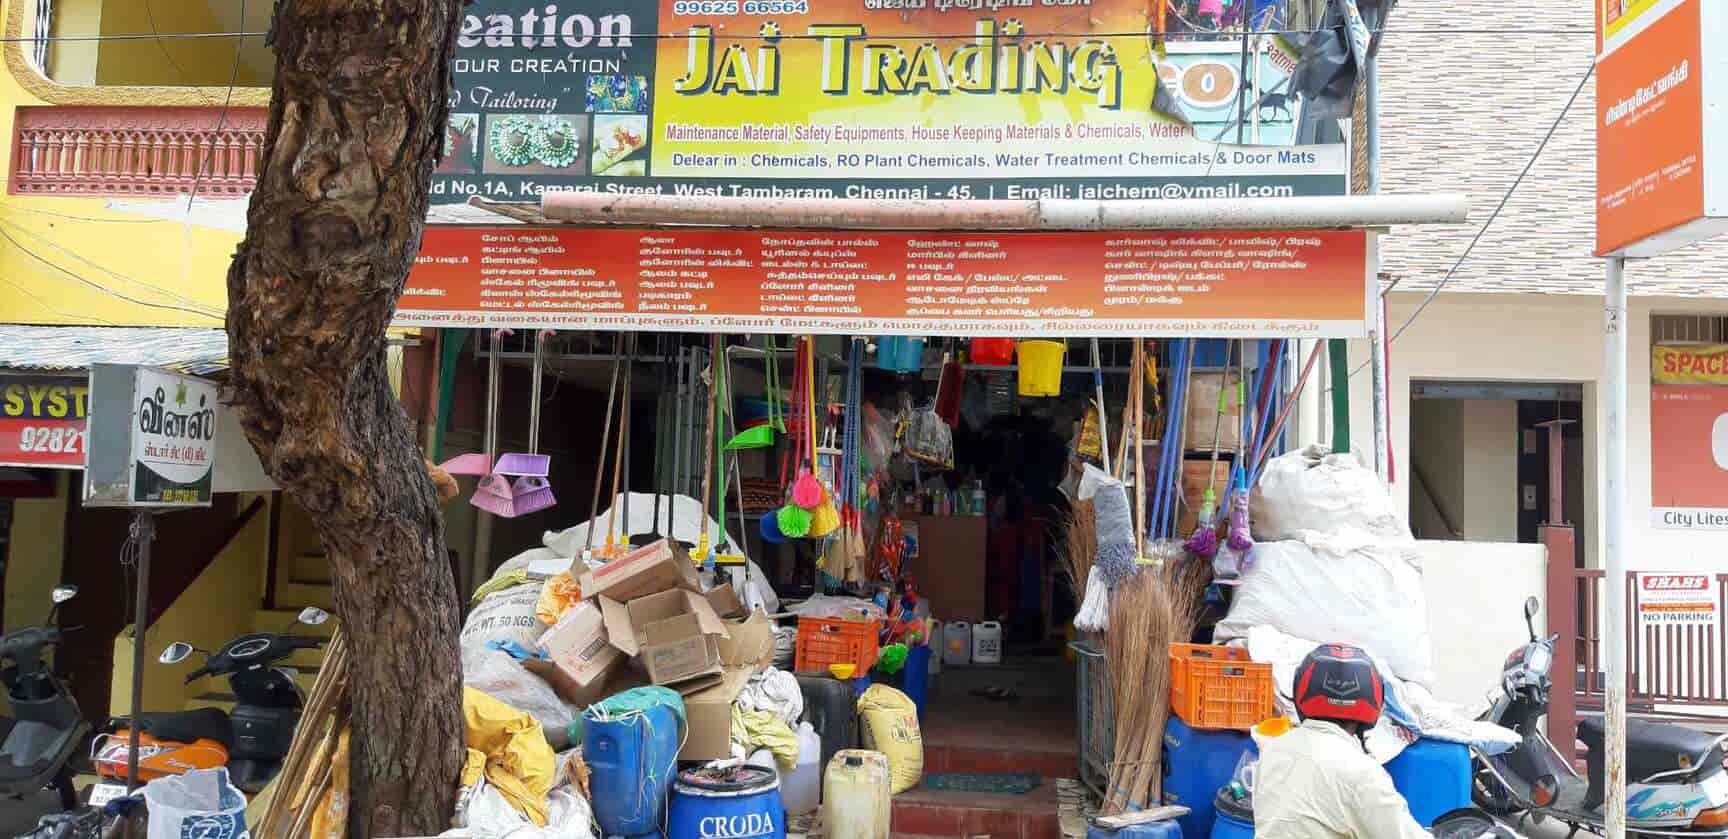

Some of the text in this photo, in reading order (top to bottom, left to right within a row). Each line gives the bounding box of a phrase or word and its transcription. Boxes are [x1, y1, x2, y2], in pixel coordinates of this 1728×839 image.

[675, 0, 808, 14] 99625 66564
[457, 4, 633, 49] eation
[455, 58, 621, 73] OUR CREATION
[666, 125, 739, 141] Maintenance
[742, 125, 789, 142] Material,
[795, 125, 831, 144] Safety
[834, 125, 907, 144] Equipments,
[911, 125, 950, 141] House
[953, 124, 1001, 144] Keeping
[1006, 123, 1059, 140] Materials
[1064, 124, 1074, 139] &
[1077, 122, 1145, 140] Chemicals,
[1149, 122, 1185, 137] Water
[672, 153, 721, 168] Delear
[725, 153, 737, 167] in
[751, 153, 833, 169] Chemicals,
[837, 154, 860, 168] RO
[864, 154, 902, 168] Plant
[995, 152, 1040, 167] Water
[1045, 151, 1123, 167] Treatment
[1128, 150, 1212, 166] Chemicals
[1215, 150, 1227, 165] &
[1232, 150, 1271, 165] Door
[1277, 149, 1316, 165] Mats
[428, 180, 445, 195] ld
[674, 183, 723, 197] West
[845, 184, 928, 200] Chennai
[1006, 184, 1072, 199] Email:
[4, 384, 88, 418] SYST
[1664, 511, 1692, 528] City
[1643, 612, 1713, 622] NO PARKING
[699, 813, 775, 839] CRODA
